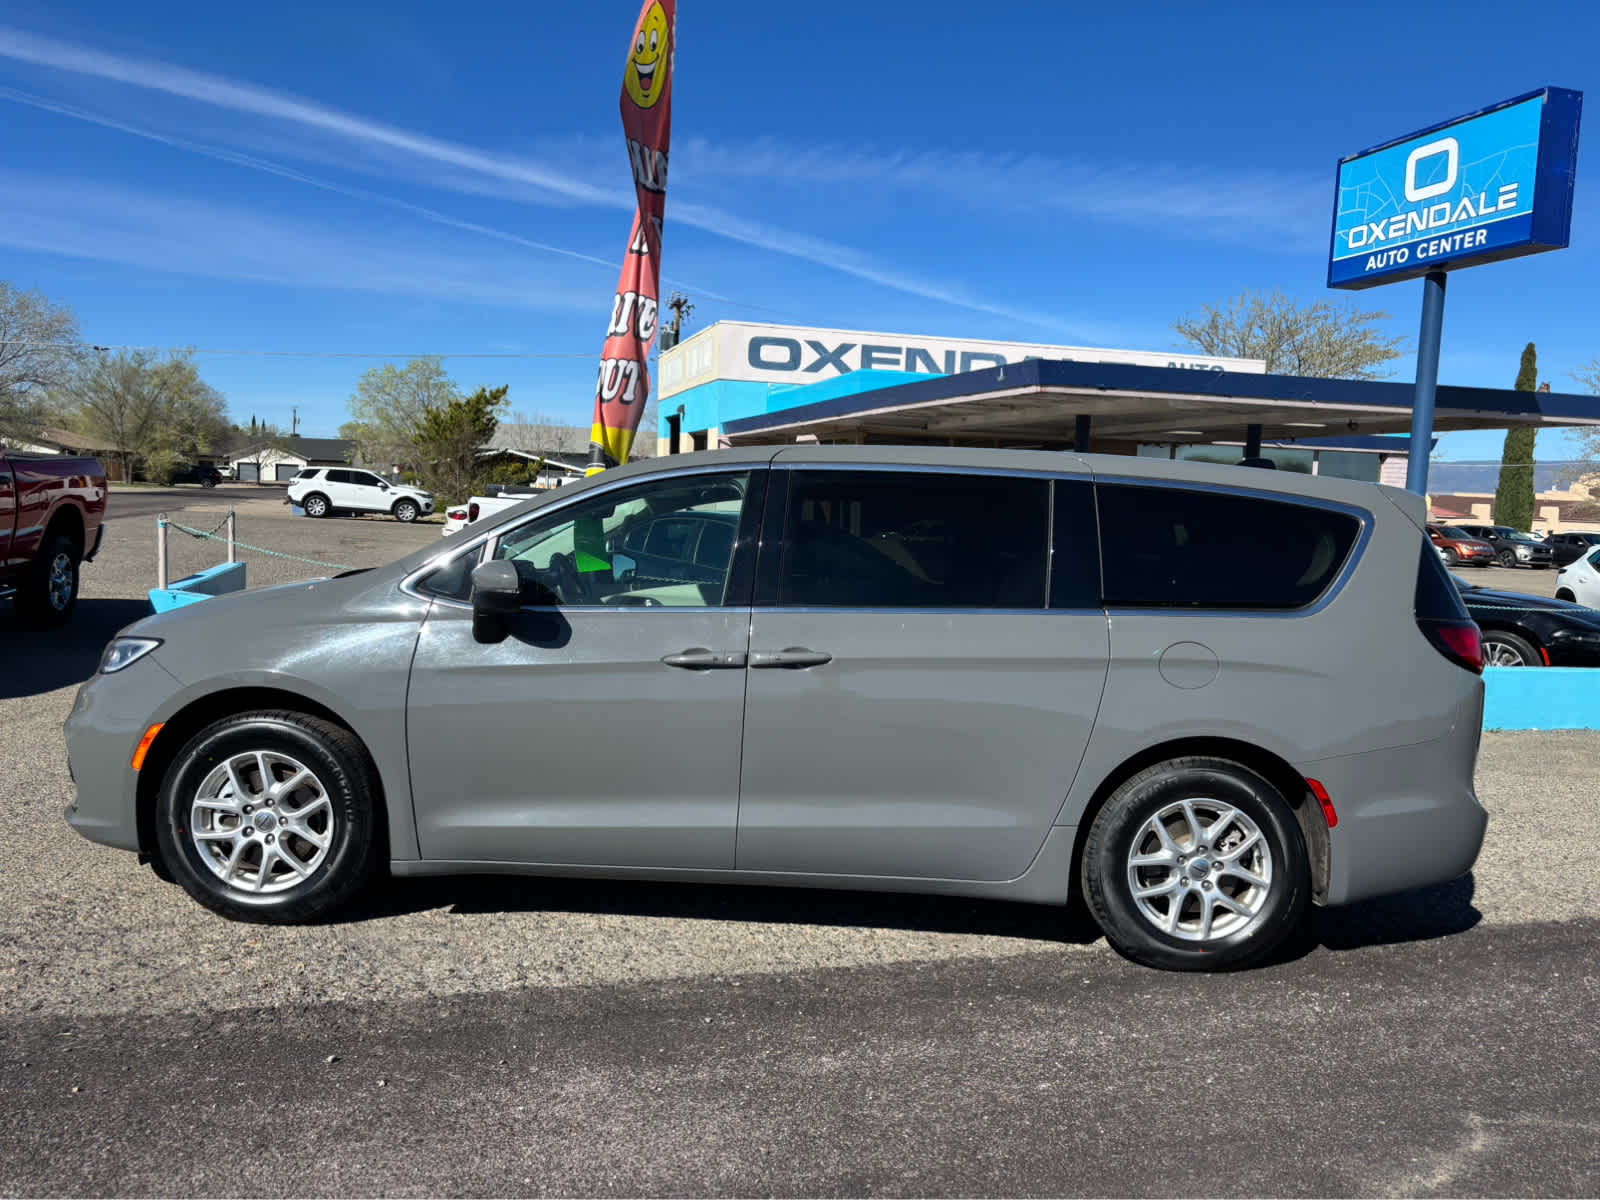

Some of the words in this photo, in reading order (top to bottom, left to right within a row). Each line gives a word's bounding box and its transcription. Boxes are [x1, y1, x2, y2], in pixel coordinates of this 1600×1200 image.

[1348, 182, 1519, 249] OXENDALE
[1365, 247, 1409, 271] AUTO
[1416, 229, 1487, 259] CENTER
[748, 336, 1136, 375] OXEND
